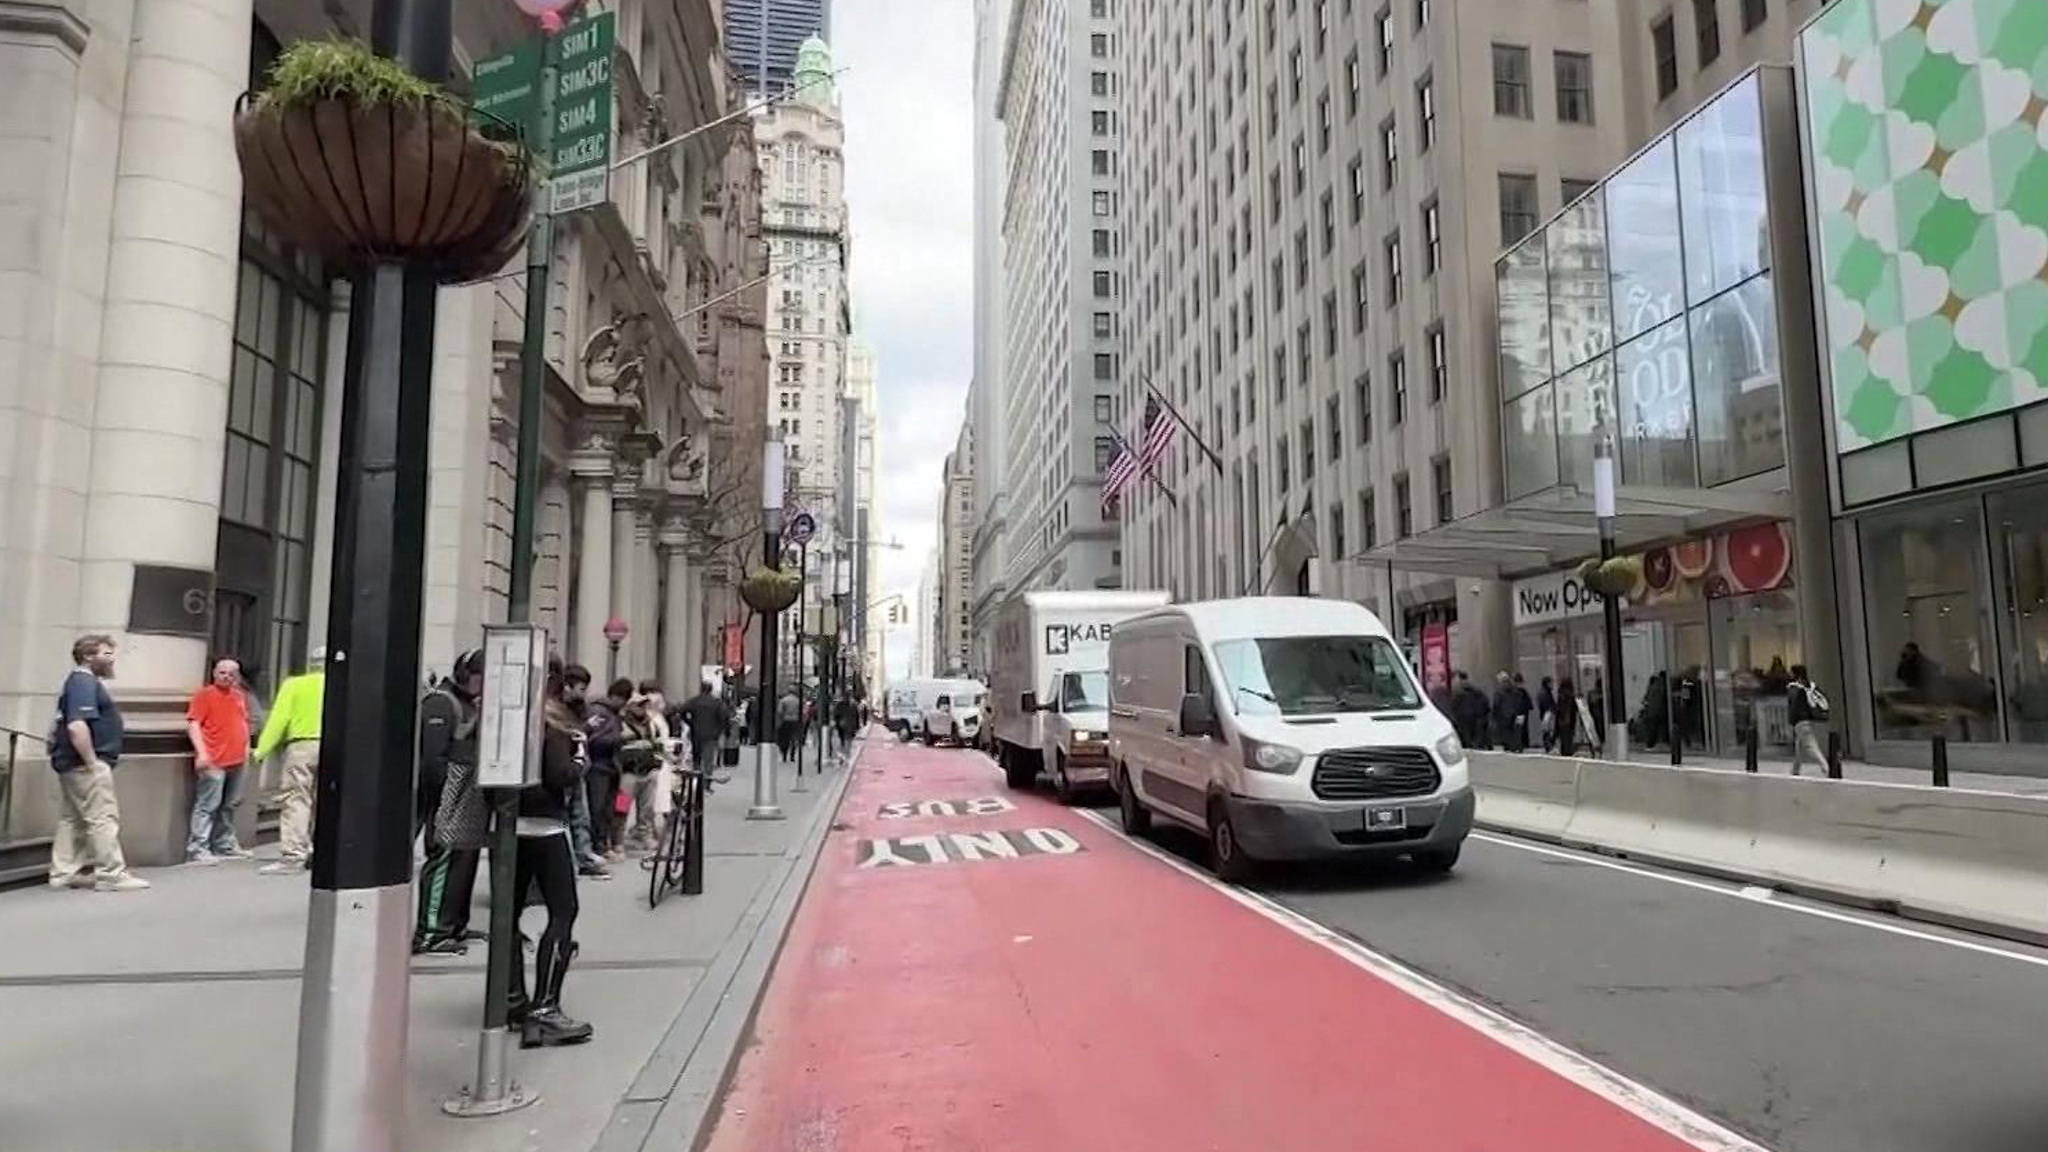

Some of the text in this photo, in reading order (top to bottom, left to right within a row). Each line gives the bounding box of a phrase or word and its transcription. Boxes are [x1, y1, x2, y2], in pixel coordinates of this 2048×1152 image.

[562, 22, 598, 59] SIM1
[560, 57, 608, 96] SIM3C
[559, 98, 597, 133] SIM4
[557, 133, 605, 169] SIM33C
[1520, 579, 1604, 616] Now Ope
[877, 796, 1018, 820] BUS
[857, 828, 1082, 869] ONLY
